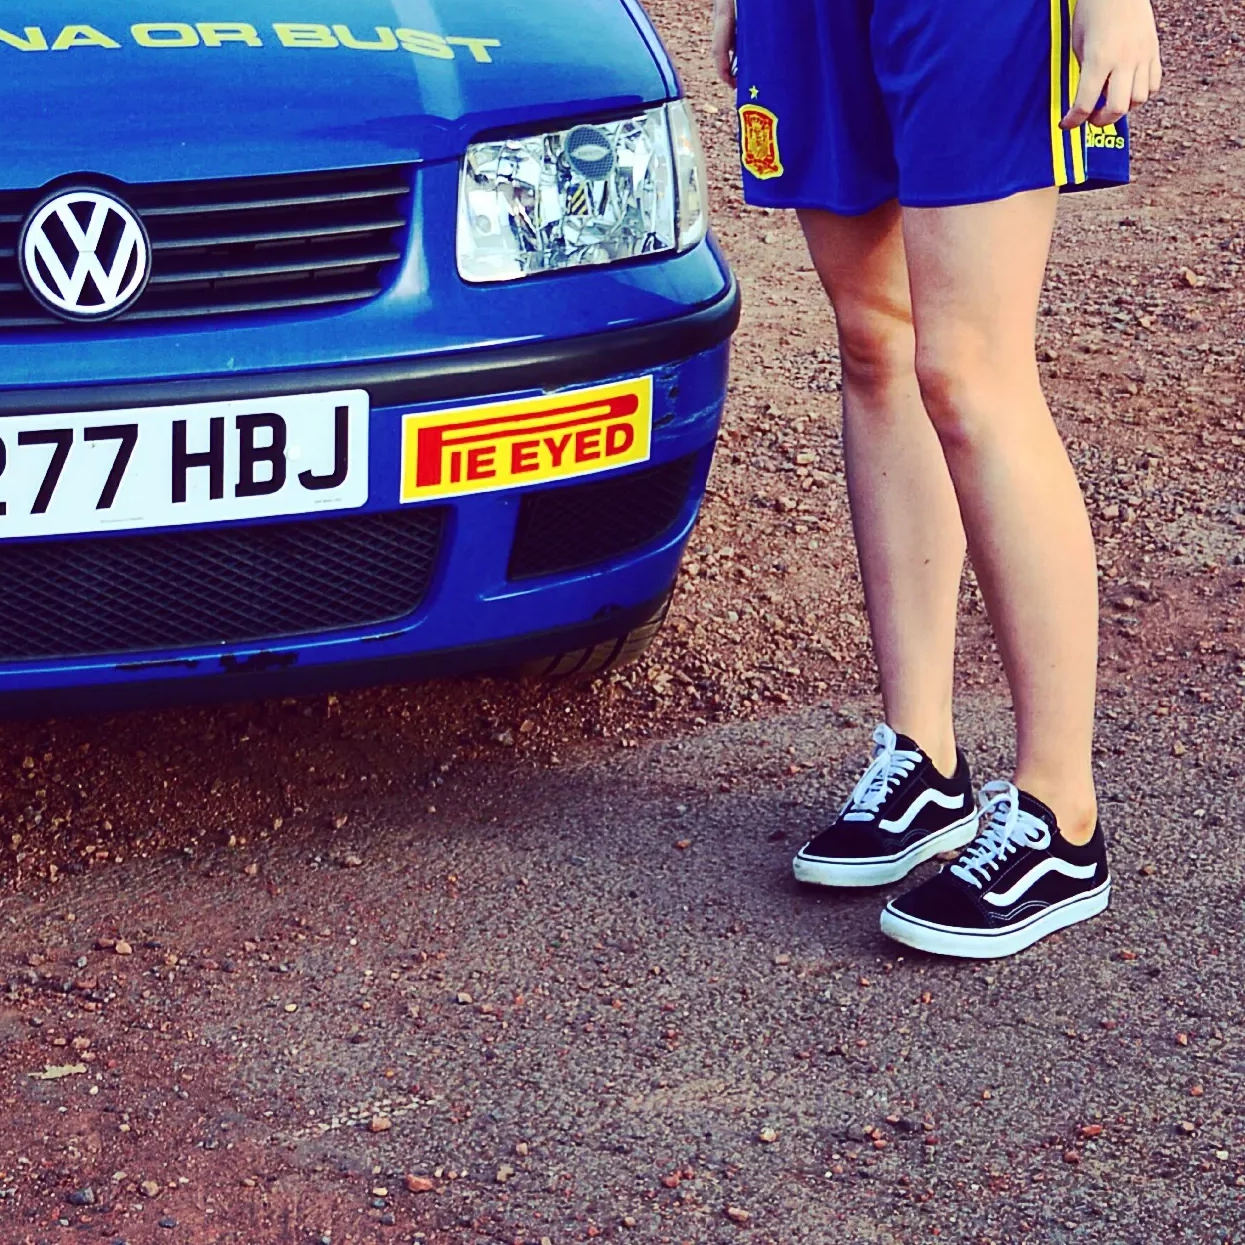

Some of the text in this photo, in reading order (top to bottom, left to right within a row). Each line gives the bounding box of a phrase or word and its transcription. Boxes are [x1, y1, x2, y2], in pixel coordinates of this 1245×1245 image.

[130, 22, 264, 48] OR
[271, 22, 502, 64] BUST
[170, 405, 351, 505] HBJ
[510, 422, 635, 475] EYED
